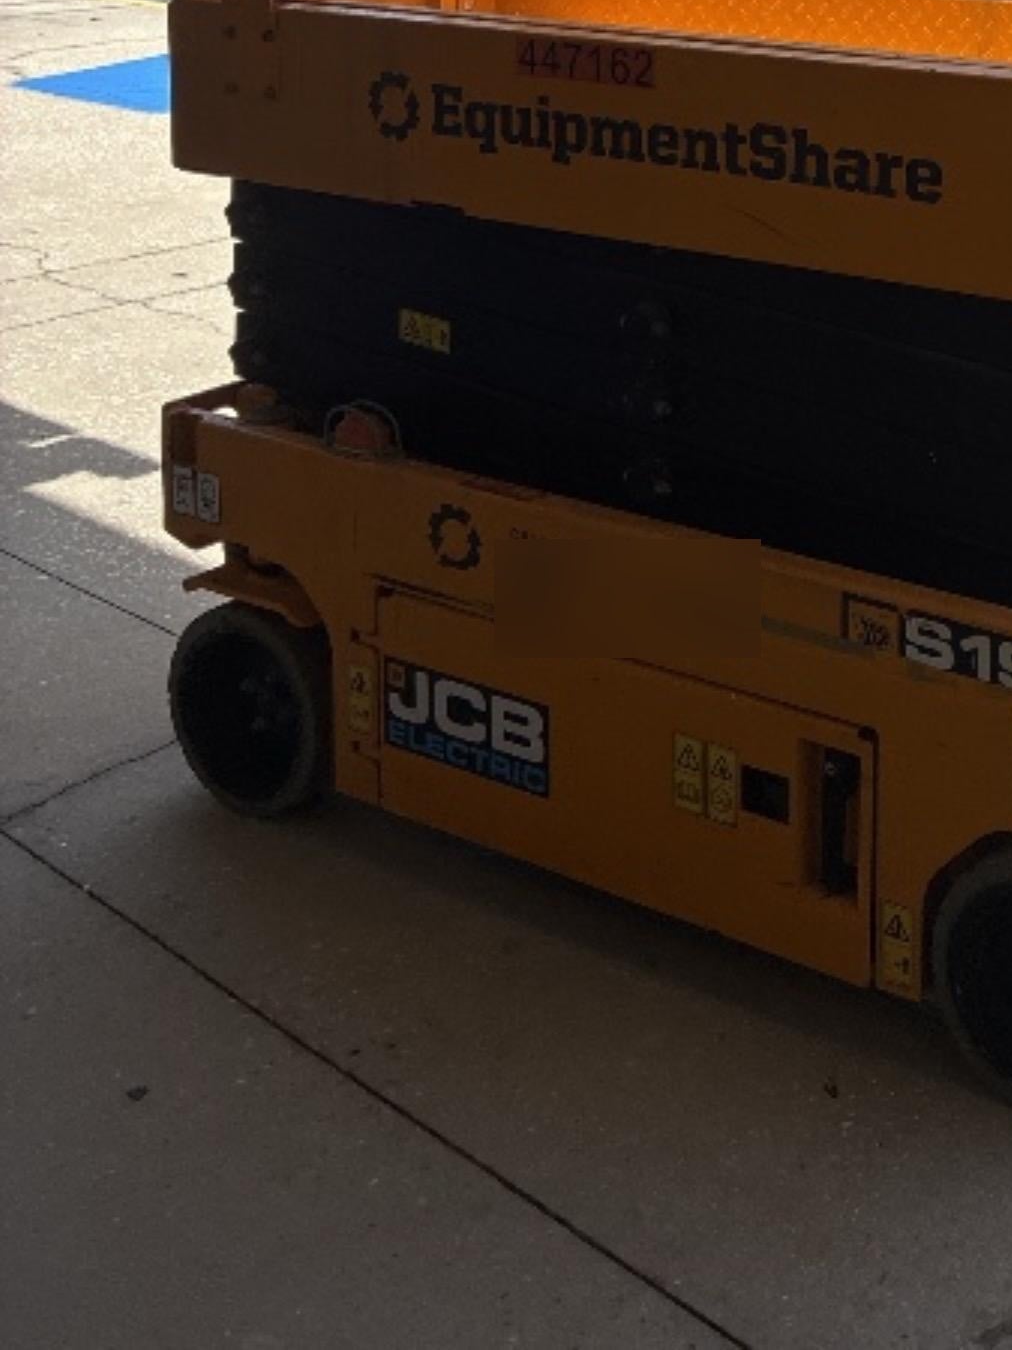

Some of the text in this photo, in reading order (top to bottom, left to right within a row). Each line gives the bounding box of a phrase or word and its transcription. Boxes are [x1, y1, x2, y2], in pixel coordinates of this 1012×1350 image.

[517, 38, 656, 88] 447162
[431, 82, 943, 205] EquipmentShare
[387, 670, 545, 764] JCB
[387, 717, 548, 795] ELECTRIC
